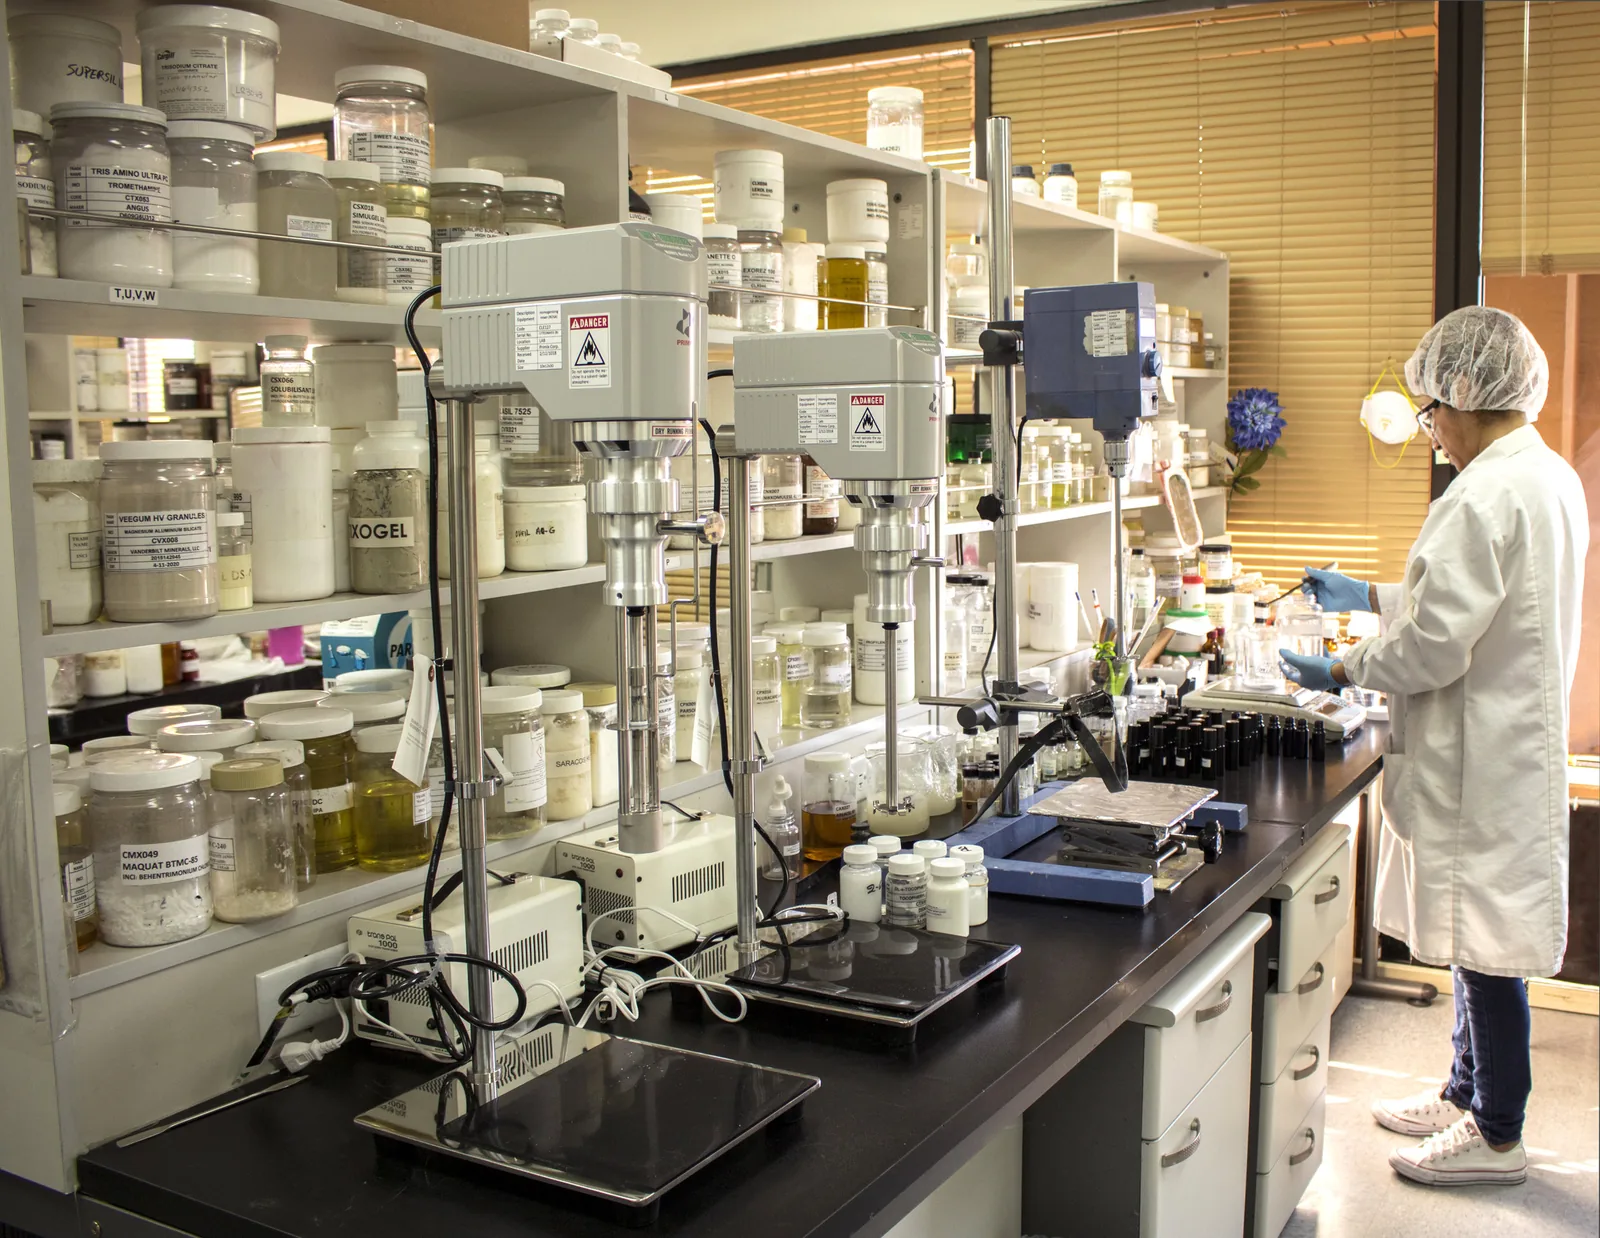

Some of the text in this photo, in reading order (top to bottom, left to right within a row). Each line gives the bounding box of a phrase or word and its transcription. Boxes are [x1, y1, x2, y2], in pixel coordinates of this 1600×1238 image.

[394, 135, 413, 143] ALMOND
[113, 170, 140, 178] AMINO
[141, 171, 162, 181] ULTRA
[17, 182, 46, 190] SODIUM
[126, 204, 150, 212] ANGUS
[353, 203, 374, 211] CSX018
[352, 212, 379, 221] SIMULGEL
[114, 288, 156, 301] T,U,V,W
[580, 316, 608, 328] DANGER
[270, 376, 294, 384] CSX066
[270, 386, 312, 394] SOLUBILISANT
[860, 396, 884, 404] DANGER
[514, 407, 532, 416] 7525
[655, 427, 665, 435] DRY
[119, 515, 151, 523] VEEGUM
[153, 514, 165, 522] HV
[167, 512, 205, 521] GRANULES
[390, 643, 413, 658] PAR
[209, 842, 227, 850] C-240
[122, 851, 159, 859] CMX049
[122, 862, 163, 871] MAQUAT
[165, 855, 199, 868] BTMC-85
[580, 861, 596, 870] 1000
[139, 866, 198, 880] BEHENTRIMONIUM
[378, 940, 398, 949] 1000
